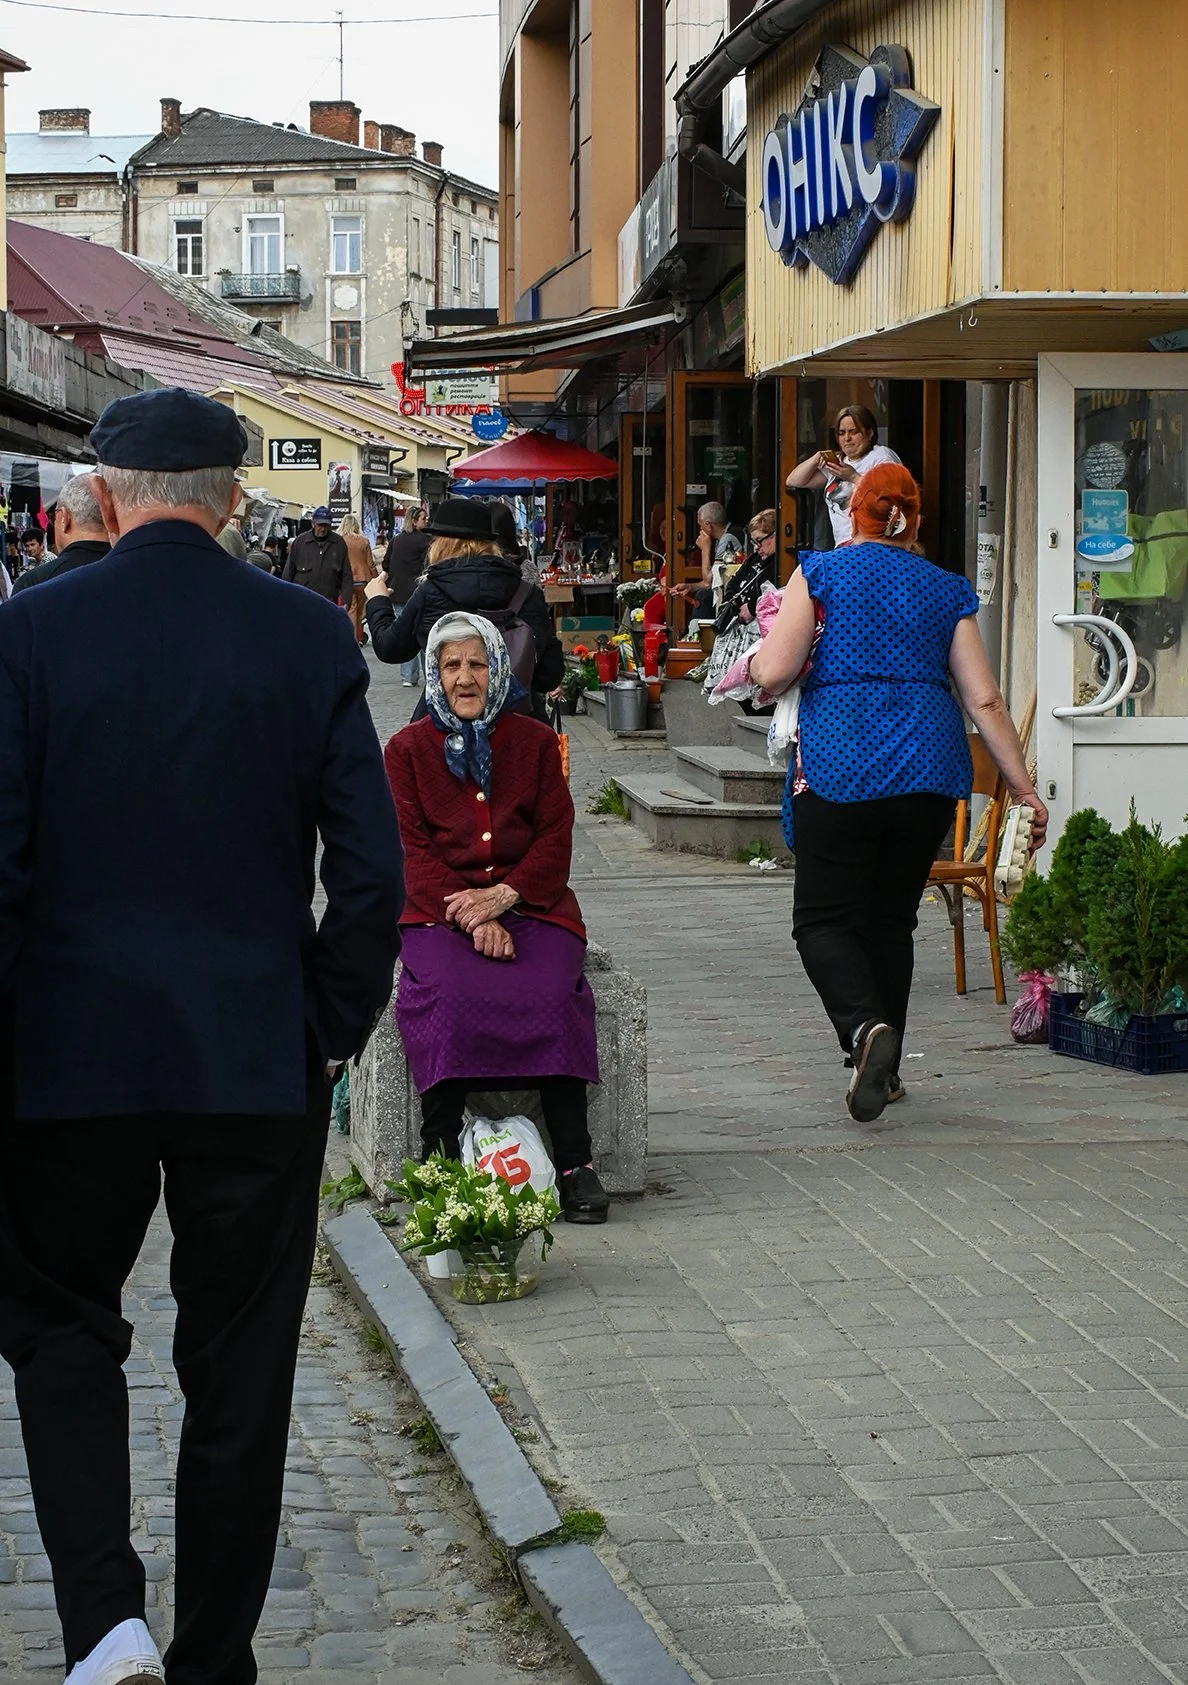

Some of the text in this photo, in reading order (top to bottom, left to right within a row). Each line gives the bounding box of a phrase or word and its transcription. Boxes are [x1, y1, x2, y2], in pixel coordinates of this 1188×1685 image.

[762, 65, 884, 253] ОНІКС
[977, 543, 995, 552] ОТА
[1085, 540, 1116, 549] На себе
